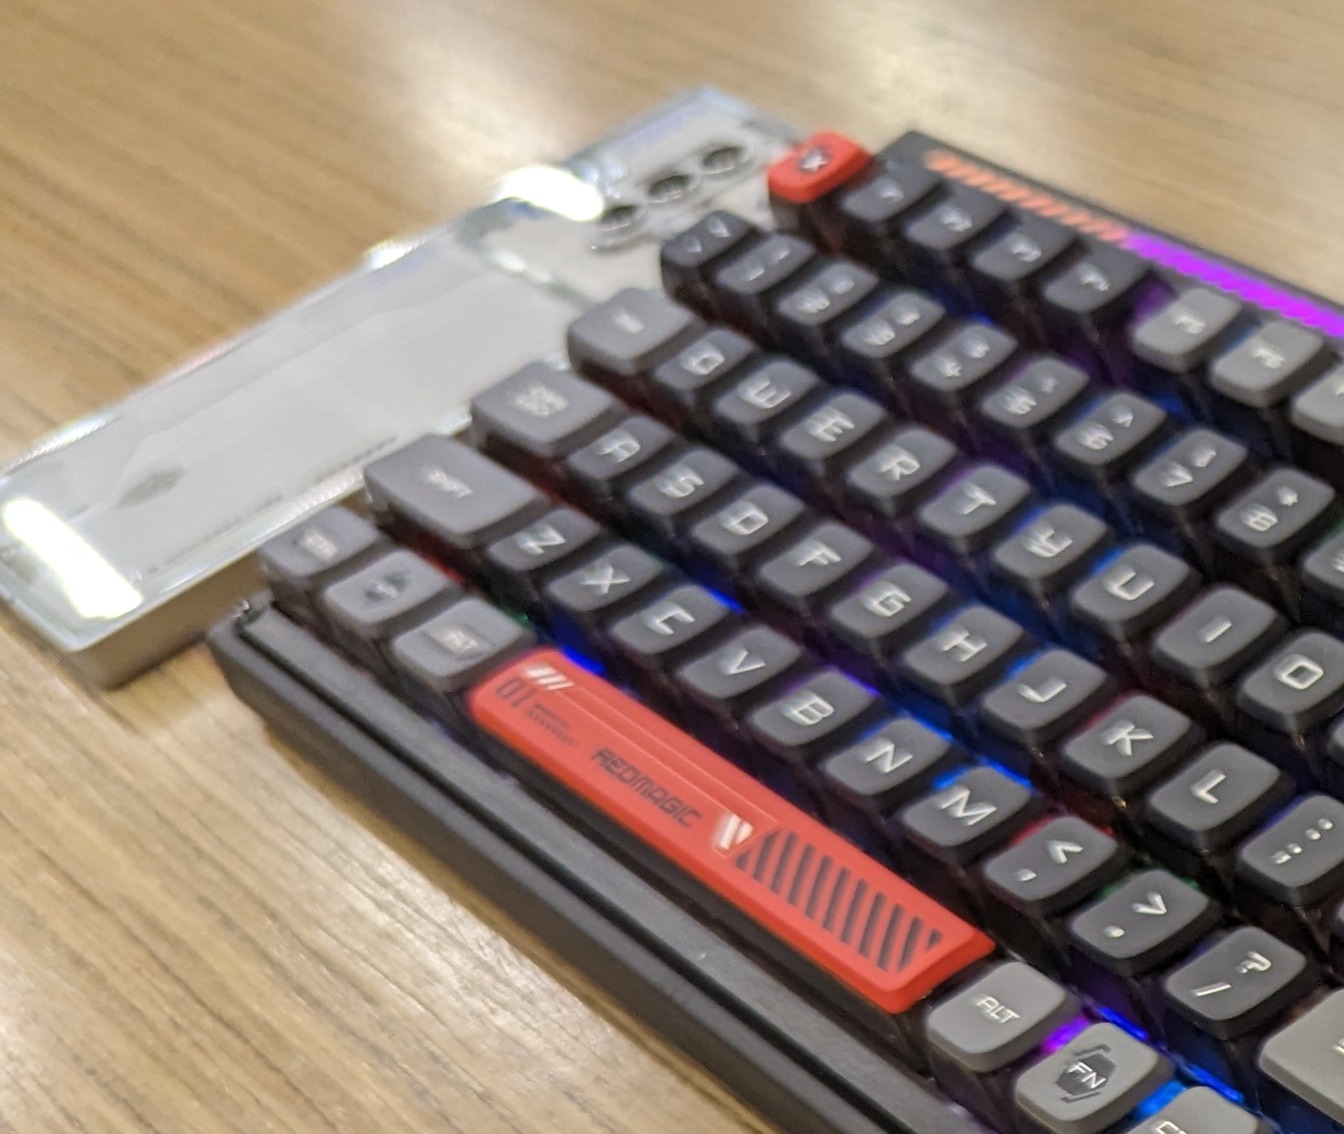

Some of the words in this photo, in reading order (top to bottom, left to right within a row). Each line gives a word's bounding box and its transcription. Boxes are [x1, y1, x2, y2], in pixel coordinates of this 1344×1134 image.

[799, 537, 842, 567] F
[580, 562, 632, 595] X
[1106, 566, 1156, 600] U
[863, 580, 912, 617] G
[642, 603, 696, 636] C
[940, 628, 988, 662] H
[721, 648, 767, 677] V
[784, 689, 836, 726] B
[1106, 720, 1154, 756] K
[864, 737, 914, 774] N
[590, 746, 704, 830] REDMAGIC
[1191, 768, 1228, 805] L
[938, 784, 998, 828] M
[976, 994, 1022, 1025] ALT
[1067, 1059, 1108, 1091] FN
